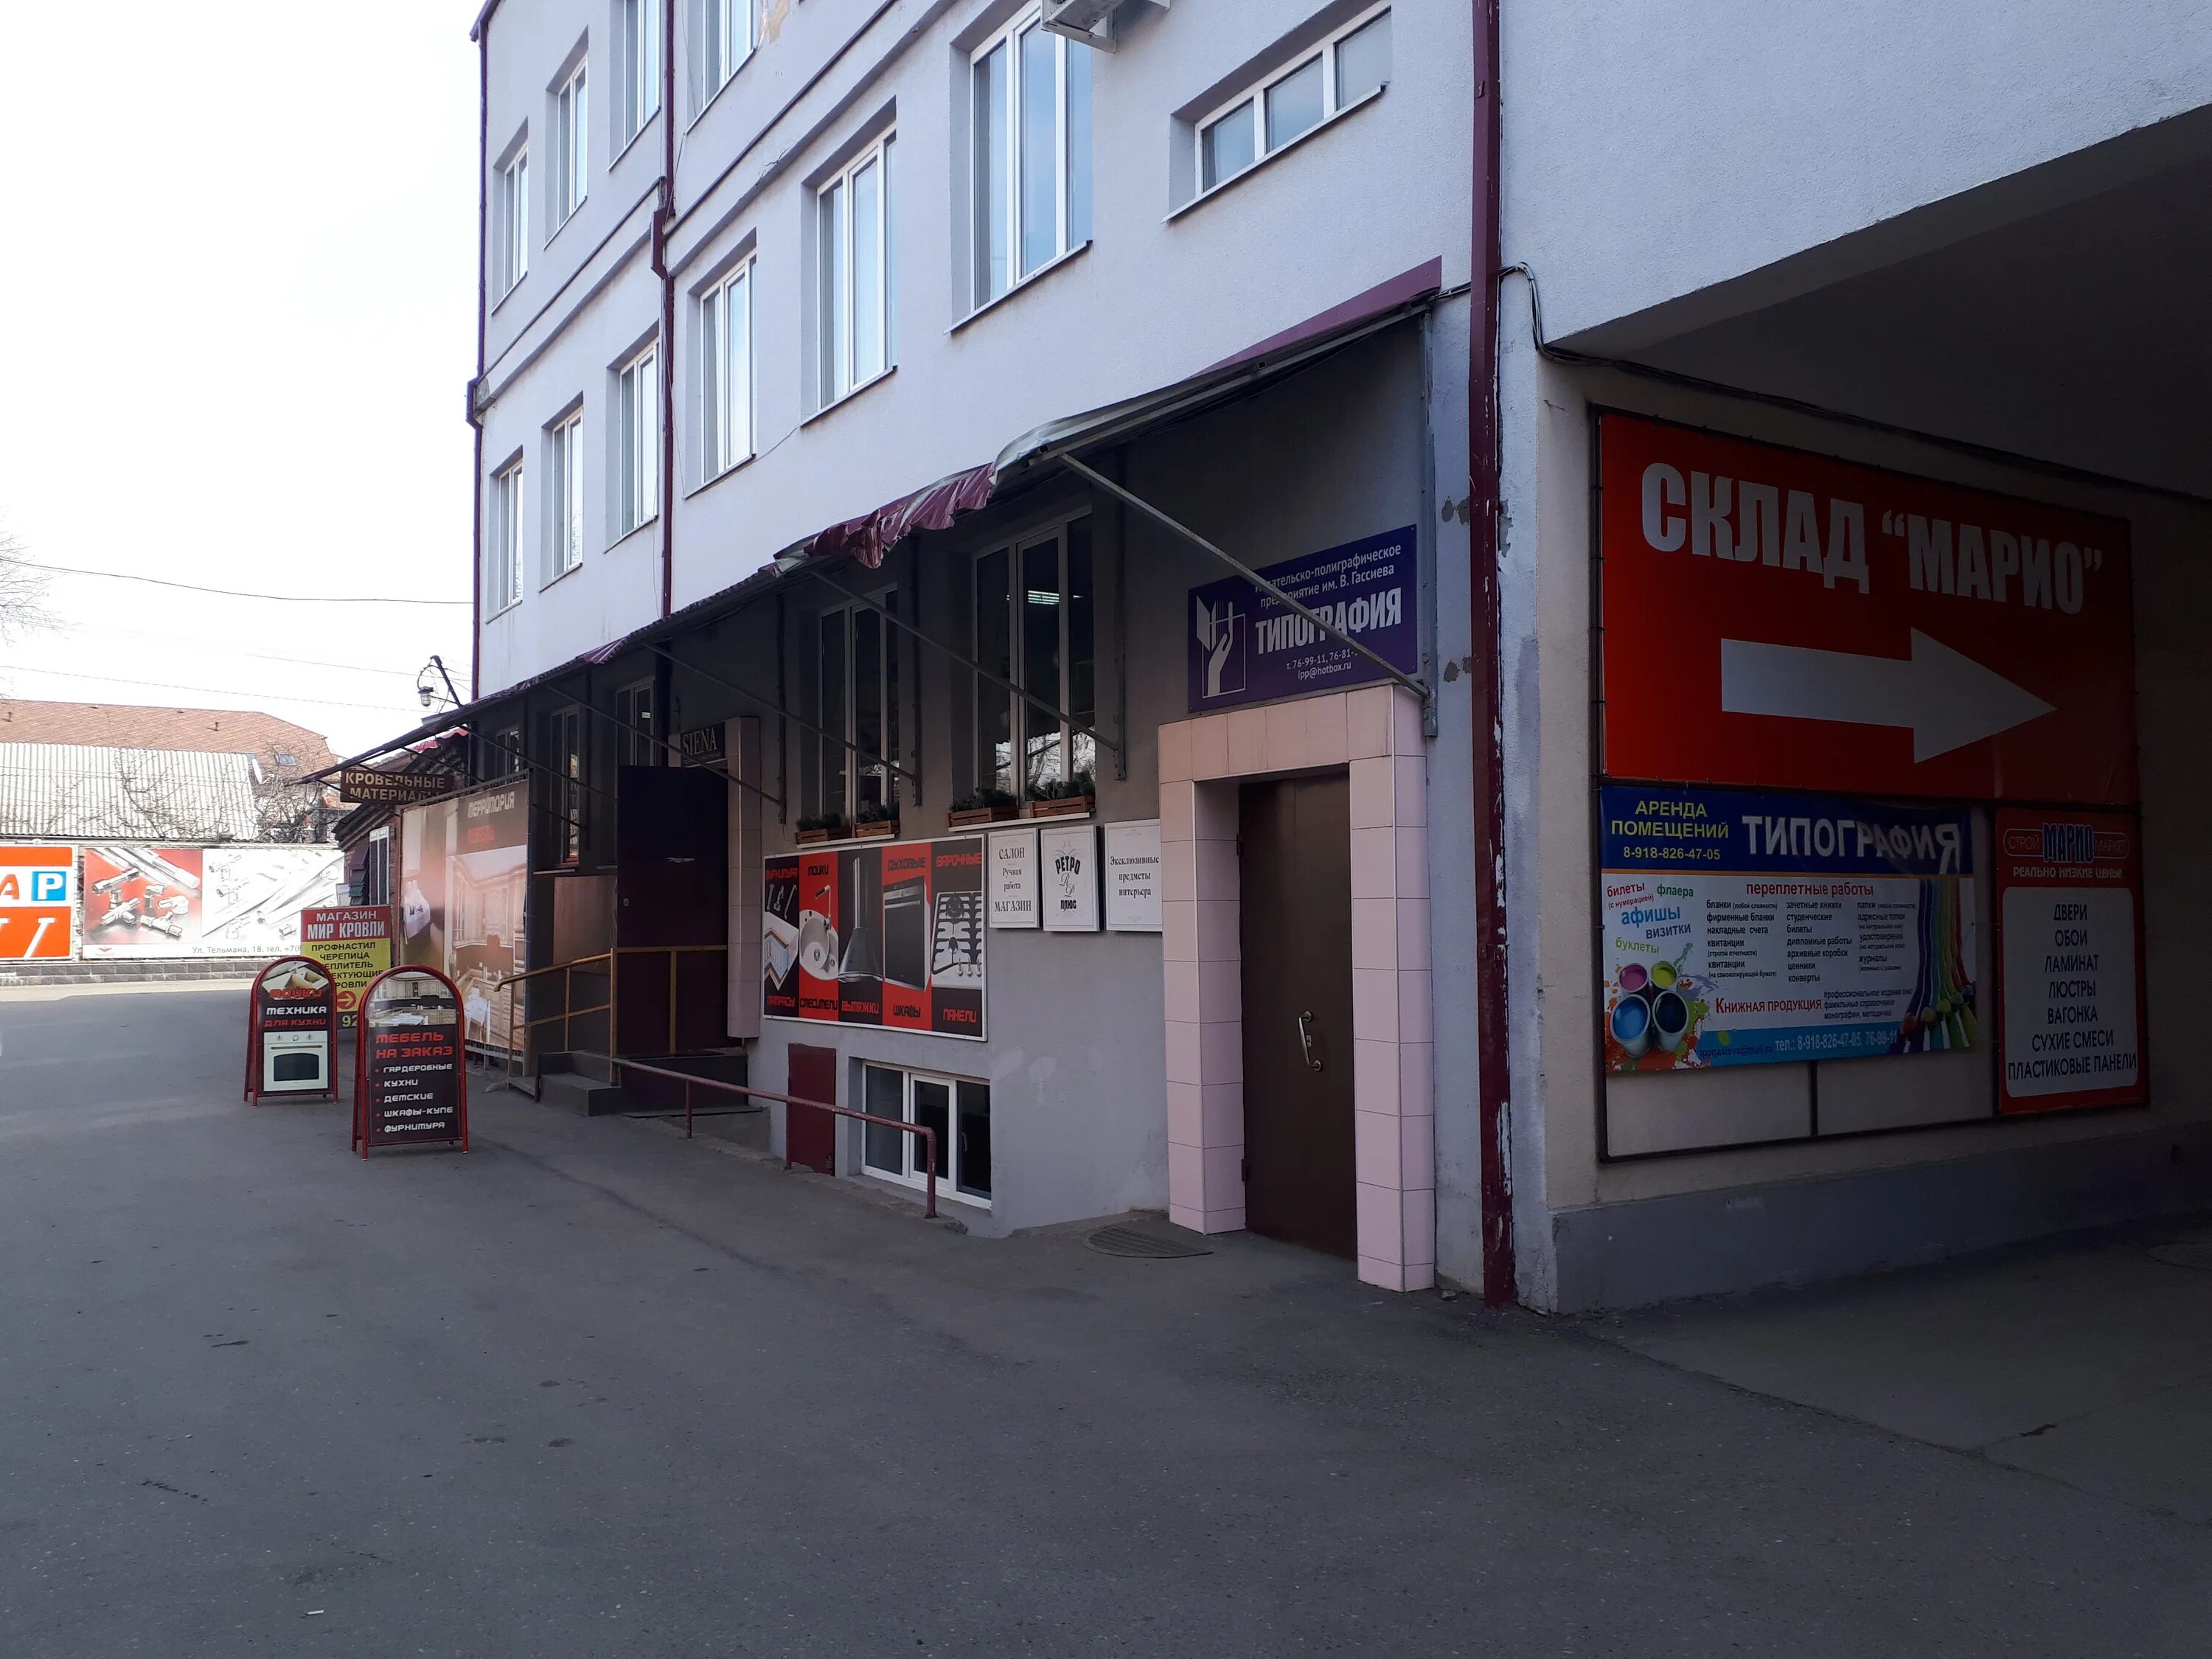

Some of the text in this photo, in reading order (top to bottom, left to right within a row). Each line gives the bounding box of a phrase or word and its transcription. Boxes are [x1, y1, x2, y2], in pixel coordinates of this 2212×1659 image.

[1641, 463, 1869, 594] СКЛАД
[1255, 544, 1402, 593] ательско-полиграфическое
[1321, 581, 1338, 592] им.
[1340, 574, 1350, 588] В.
[1352, 563, 1395, 585] Гассиева
[1255, 587, 1402, 655] ТИПОГРАФИЯ
[1292, 653, 1329, 668] 76-99-11,
[1298, 662, 1352, 681] ipp@hotbox.ru
[683, 727, 718, 756] SIENA
[345, 772, 445, 789] КРОВЕЛЬНЫЕ
[1635, 800, 1708, 818] АРЕНДА
[1611, 820, 1729, 839] ПОМЕЩЕНИЙ
[1742, 815, 1961, 874] ТИПОГРАФИЯ
[2008, 834, 2041, 850] СТРОЙ
[2043, 823, 2094, 863] МАРИО
[936, 852, 982, 868] ВАРОЧНЫЕ
[998, 847, 1025, 860] САЛОН
[1110, 855, 1160, 866] Эксклюзивные
[1623, 846, 1720, 861] 8-918-826-47-05
[888, 857, 926, 872] ДУХОВЫЕ
[1054, 855, 1081, 875] РЕТРО
[1003, 867, 1022, 878] Ручная
[1119, 872, 1151, 881] предметы
[2013, 866, 2056, 878] РЕАЛЬНО
[2059, 866, 2094, 879] НИЗКИЕ
[1004, 880, 1021, 892] работа
[1119, 888, 1152, 898] интерьера
[1607, 883, 1645, 897] билеты
[1657, 884, 1694, 899] флаера
[1747, 882, 1874, 897] переплетные работы
[994, 900, 1032, 912] МАГАЗИН
[1615, 893, 1654, 908] нумерацией)
[1706, 900, 1731, 908] бланки
[316, 910, 377, 922] МАГАЗИН
[1621, 906, 1680, 928] афишы
[1706, 913, 1775, 923] фирменные бланки
[1787, 914, 1832, 922] студенческие
[2053, 904, 2087, 921] ДВЕРИ
[307, 921, 385, 939] МИР КРОВЛИ
[1646, 924, 1691, 939] визитки
[1707, 927, 1746, 935] накладные
[1787, 924, 1812, 933] билеты
[1615, 937, 1659, 954] буклеты
[1787, 936, 1852, 947] дипломные работы
[2055, 930, 2087, 947] ОБОИ
[207, 945, 249, 954] Тельмана,
[311, 942, 376, 952] ПРОФНАСТИЛ
[1787, 948, 1848, 959] архивные коробки
[319, 952, 370, 961] ЧЕРЕПИЦА
[1859, 956, 1888, 964] журналы
[324, 961, 374, 970] ЕПЛИТЕЛЬ
[1708, 961, 1745, 969] квитанции
[2045, 955, 2098, 973] ЛАМИНАТ
[336, 981, 367, 989] РОВЛИ
[1788, 975, 1820, 984] конверты
[2049, 980, 2096, 998] ЛЮСТРЫ
[266, 1006, 327, 1015] ТЕХНИКА
[799, 998, 838, 1011] СМЕСИТЕЛИ
[841, 999, 880, 1015] ВЫТЯЖКИ
[893, 1004, 922, 1019] ШКАФЫ
[942, 1008, 977, 1023] ПАНЕЛИ
[2048, 1006, 2098, 1025] ВАГОНКА
[265, 1018, 327, 1028] ДЛЯ КУХНИ
[375, 1032, 445, 1044] МЕБЕЛЬ
[1775, 1039, 1795, 1051] тел.:
[2032, 1030, 2114, 1052] СУХИЕ СМЕСИ
[375, 1046, 453, 1060] НА ЗАКАЗ
[383, 1063, 453, 1074] ГАРДЕРОБНЫЕ
[2008, 1052, 2138, 1080] ПЛАСТИКОВЫЕ ПАНЕЛИ
[383, 1079, 418, 1088] КУХНИ
[383, 1093, 434, 1104] ДЕТСКИЕ
[383, 1107, 453, 1118] ШКАФЫ-КУПЕ
[384, 1121, 445, 1133] ФУРНИТУРА
